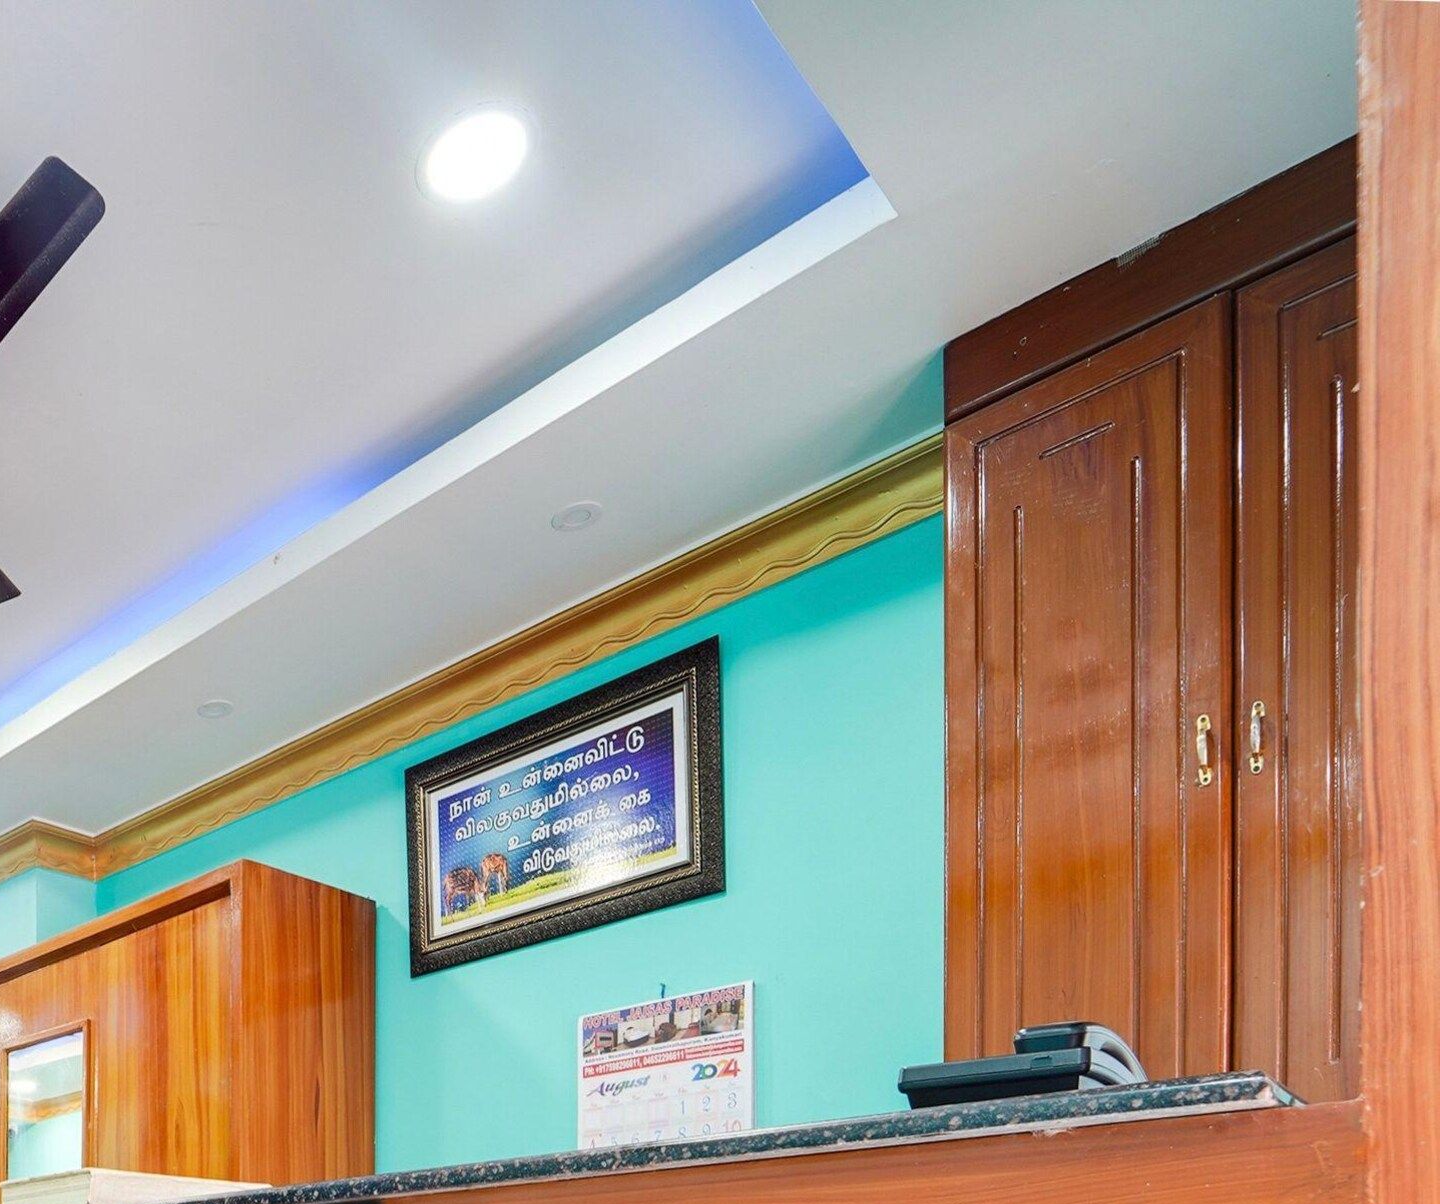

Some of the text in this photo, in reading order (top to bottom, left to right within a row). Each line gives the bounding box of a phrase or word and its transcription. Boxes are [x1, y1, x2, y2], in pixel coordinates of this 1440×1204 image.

[449, 727, 645, 822] நான் உன்னைவிட்டு
[455, 764, 640, 841] விலகுவதுமில்லை,
[619, 787, 651, 812] கை
[583, 1011, 624, 1029] HOTEL
[691, 1058, 742, 1081] 2024
[586, 1075, 651, 1097] August
[702, 1096, 711, 1112] 2
[727, 1093, 738, 1109] 3
